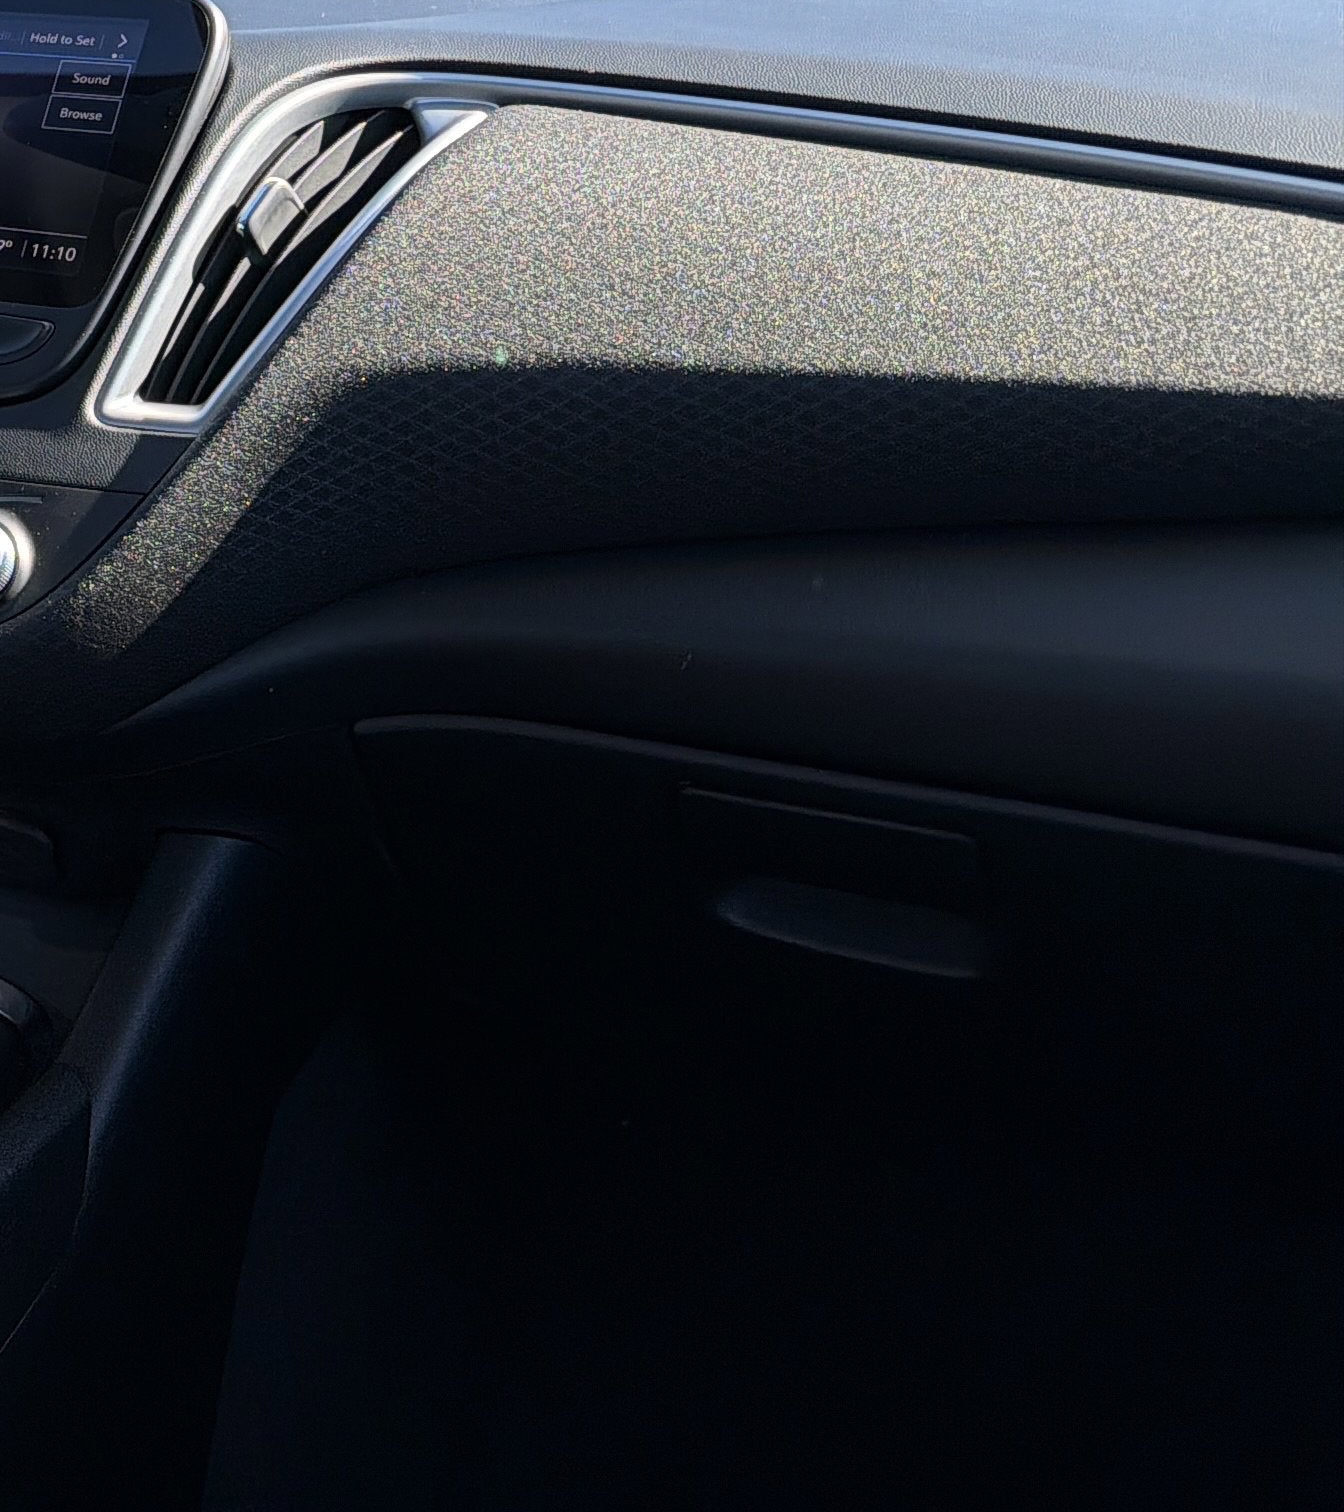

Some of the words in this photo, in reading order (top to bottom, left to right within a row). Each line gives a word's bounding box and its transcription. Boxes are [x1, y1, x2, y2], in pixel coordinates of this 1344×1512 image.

[30, 32, 58, 45] Hold
[61, 34, 73, 45] to
[75, 35, 95, 47] Set
[72, 72, 111, 86] Sound
[59, 108, 102, 121] Browse
[32, 243, 76, 262] 11:10
